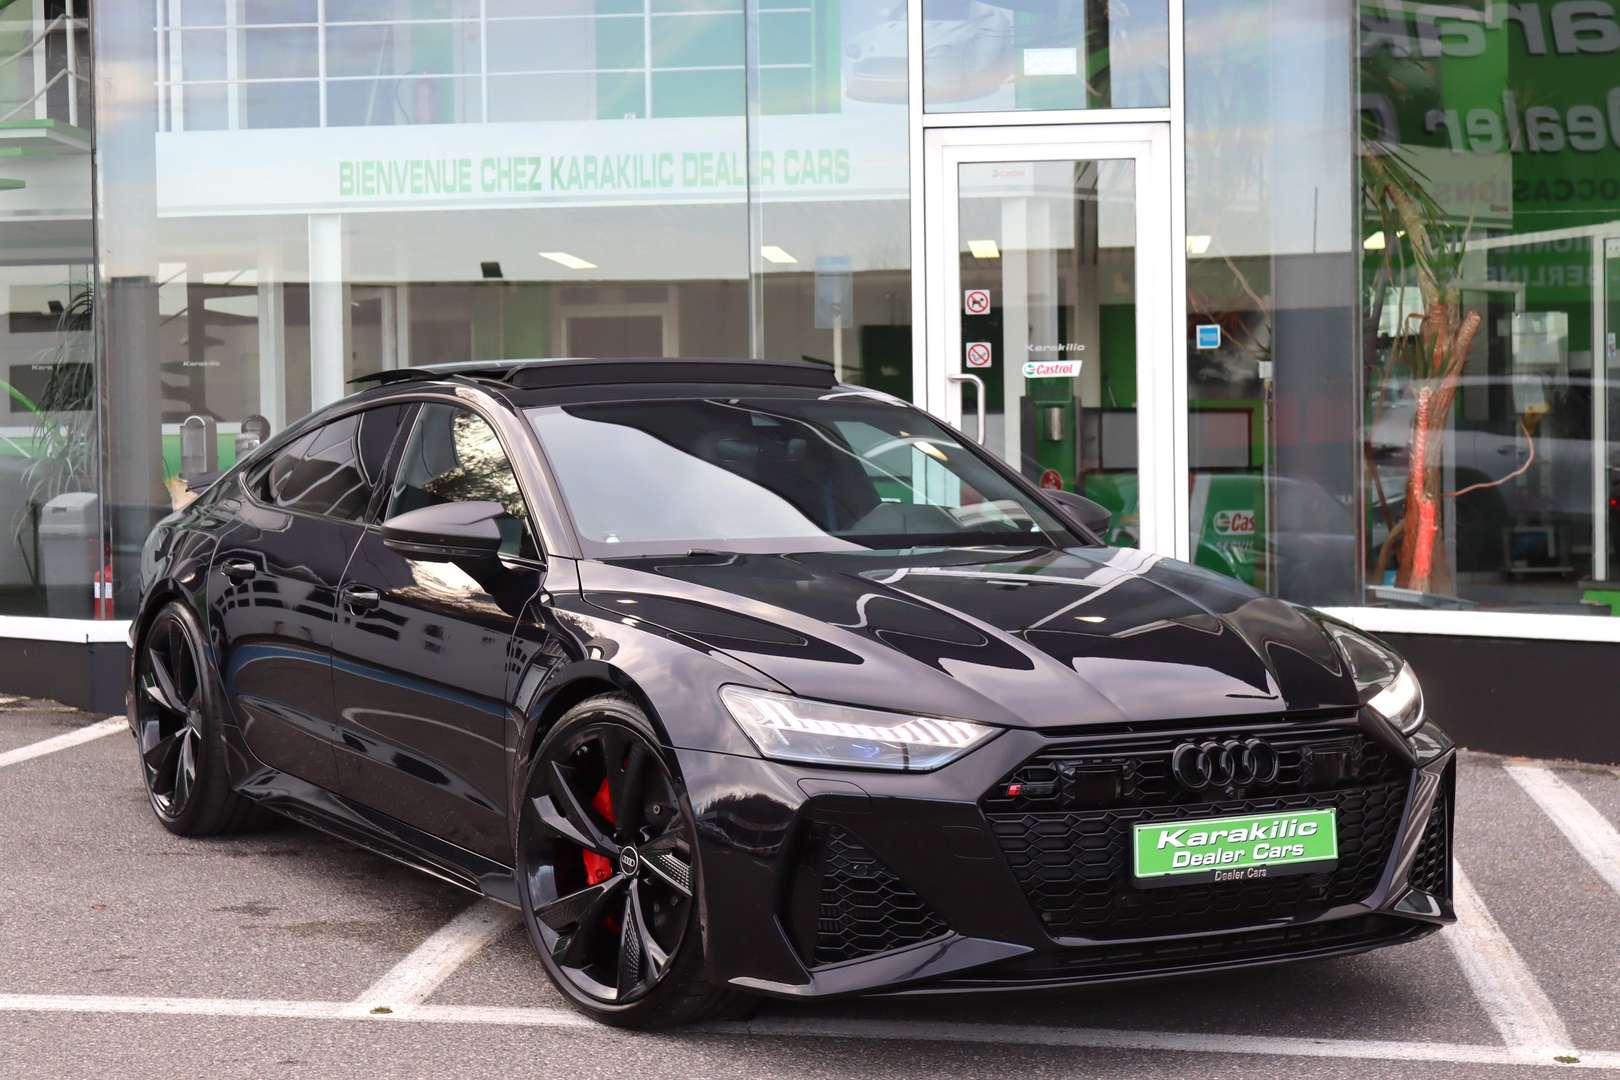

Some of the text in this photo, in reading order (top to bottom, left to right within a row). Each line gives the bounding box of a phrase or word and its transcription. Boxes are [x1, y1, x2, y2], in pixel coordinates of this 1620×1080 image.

[339, 159, 472, 196] BIENVENUE
[480, 156, 542, 192] CHEZ
[550, 153, 674, 190] KARAKILIC
[783, 148, 850, 184] CARS
[1036, 363, 1074, 375] Castrol
[1157, 818, 1318, 849] Karakilic
[1172, 843, 1304, 868] Dealer Cars
[1214, 866, 1267, 881] Dealer Cars
